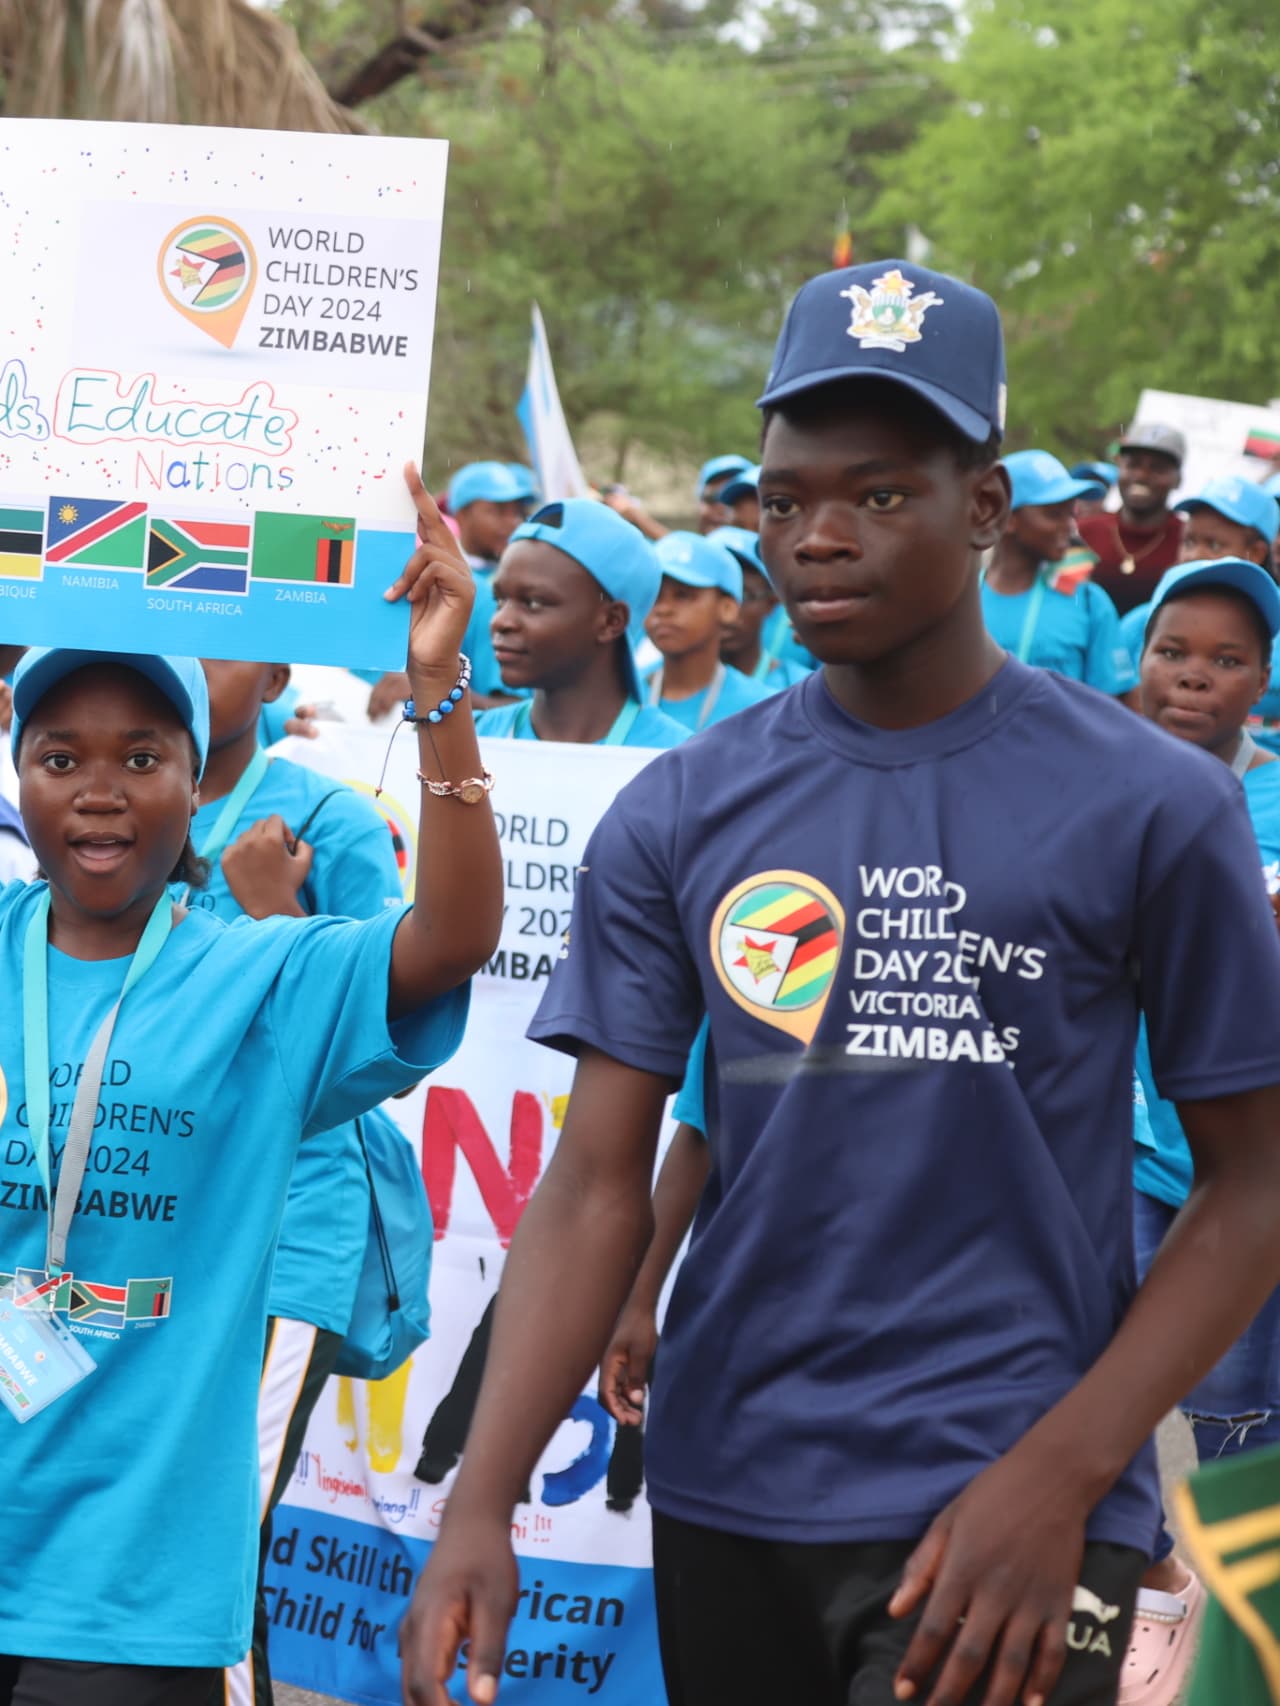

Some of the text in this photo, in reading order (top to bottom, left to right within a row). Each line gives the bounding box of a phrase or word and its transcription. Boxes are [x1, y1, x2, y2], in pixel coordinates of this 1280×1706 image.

[269, 226, 365, 254] WORLD
[266, 260, 419, 291] CHILDREN'S
[263, 293, 382, 322] DAY 2024
[258, 326, 408, 357] ZIMBABWE
[68, 377, 285, 446] Educate
[136, 450, 294, 491] Nations
[61, 574, 120, 591] NAMIBIA
[274, 588, 328, 605] ZAMBIA
[146, 597, 243, 617] SOUTH AFRICA
[493, 812, 569, 847] ORLD
[854, 948, 929, 982] DAY
[849, 989, 981, 1020] VICTORIA
[70, 1325, 121, 1341] SOUTH AFRICA
[306, 1535, 378, 1588] Skill
[379, 1553, 413, 1596] th
[348, 1607, 386, 1653] for
